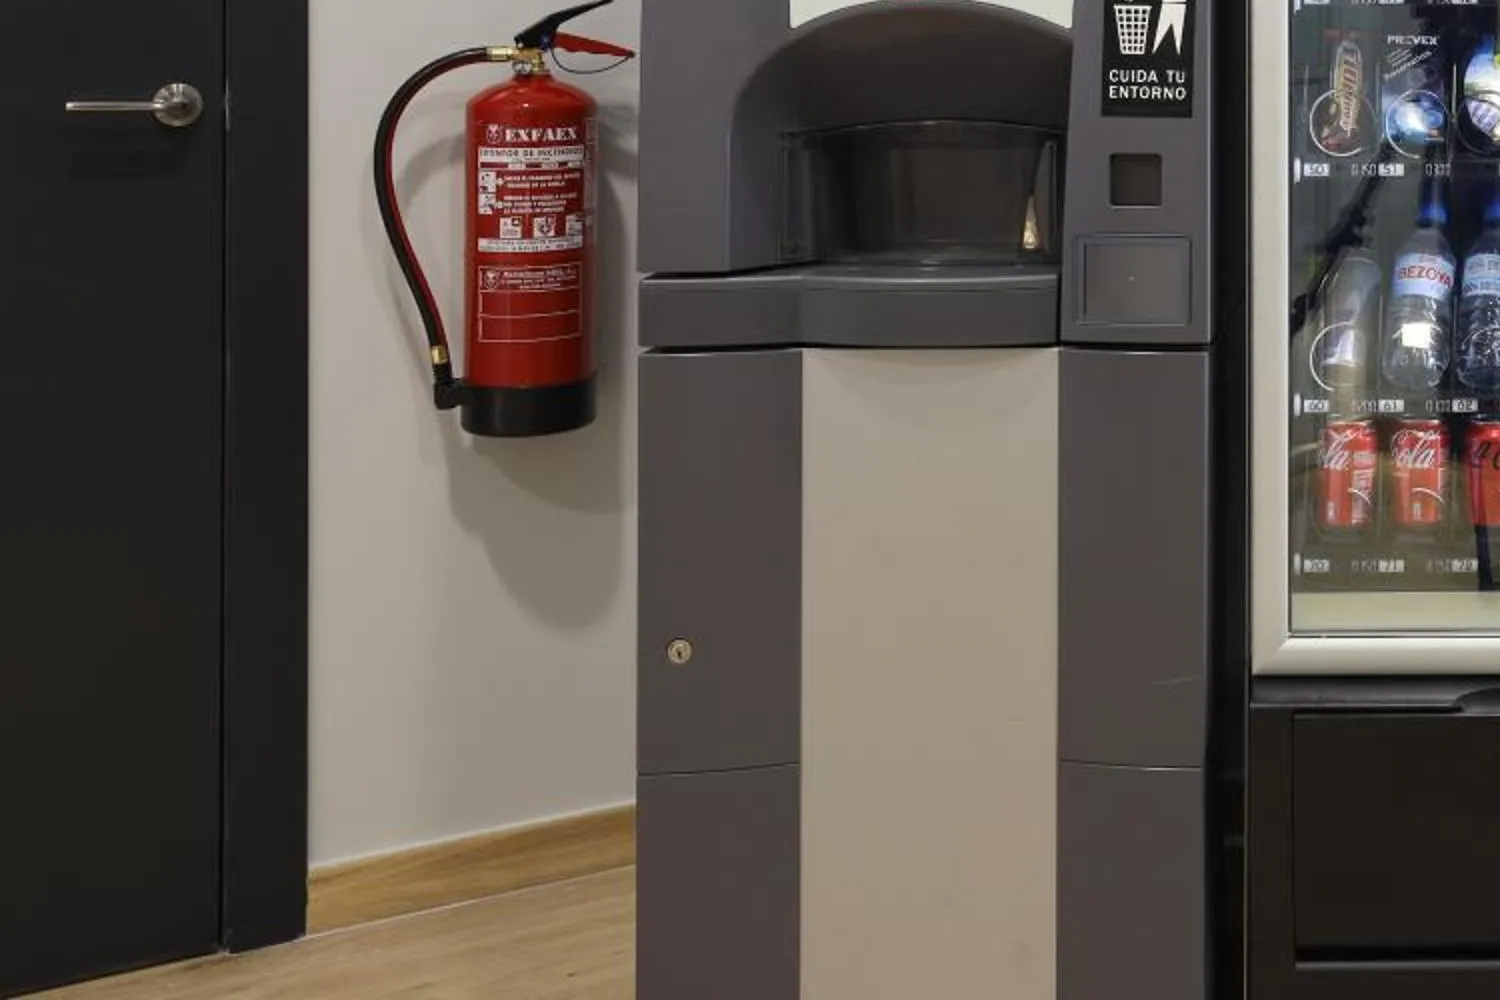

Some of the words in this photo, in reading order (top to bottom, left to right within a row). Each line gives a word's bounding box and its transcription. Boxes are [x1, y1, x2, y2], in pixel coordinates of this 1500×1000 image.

[1108, 70, 1158, 83] CUIDA
[1166, 70, 1185, 84] TU
[1109, 86, 1186, 100] ENTORNO
